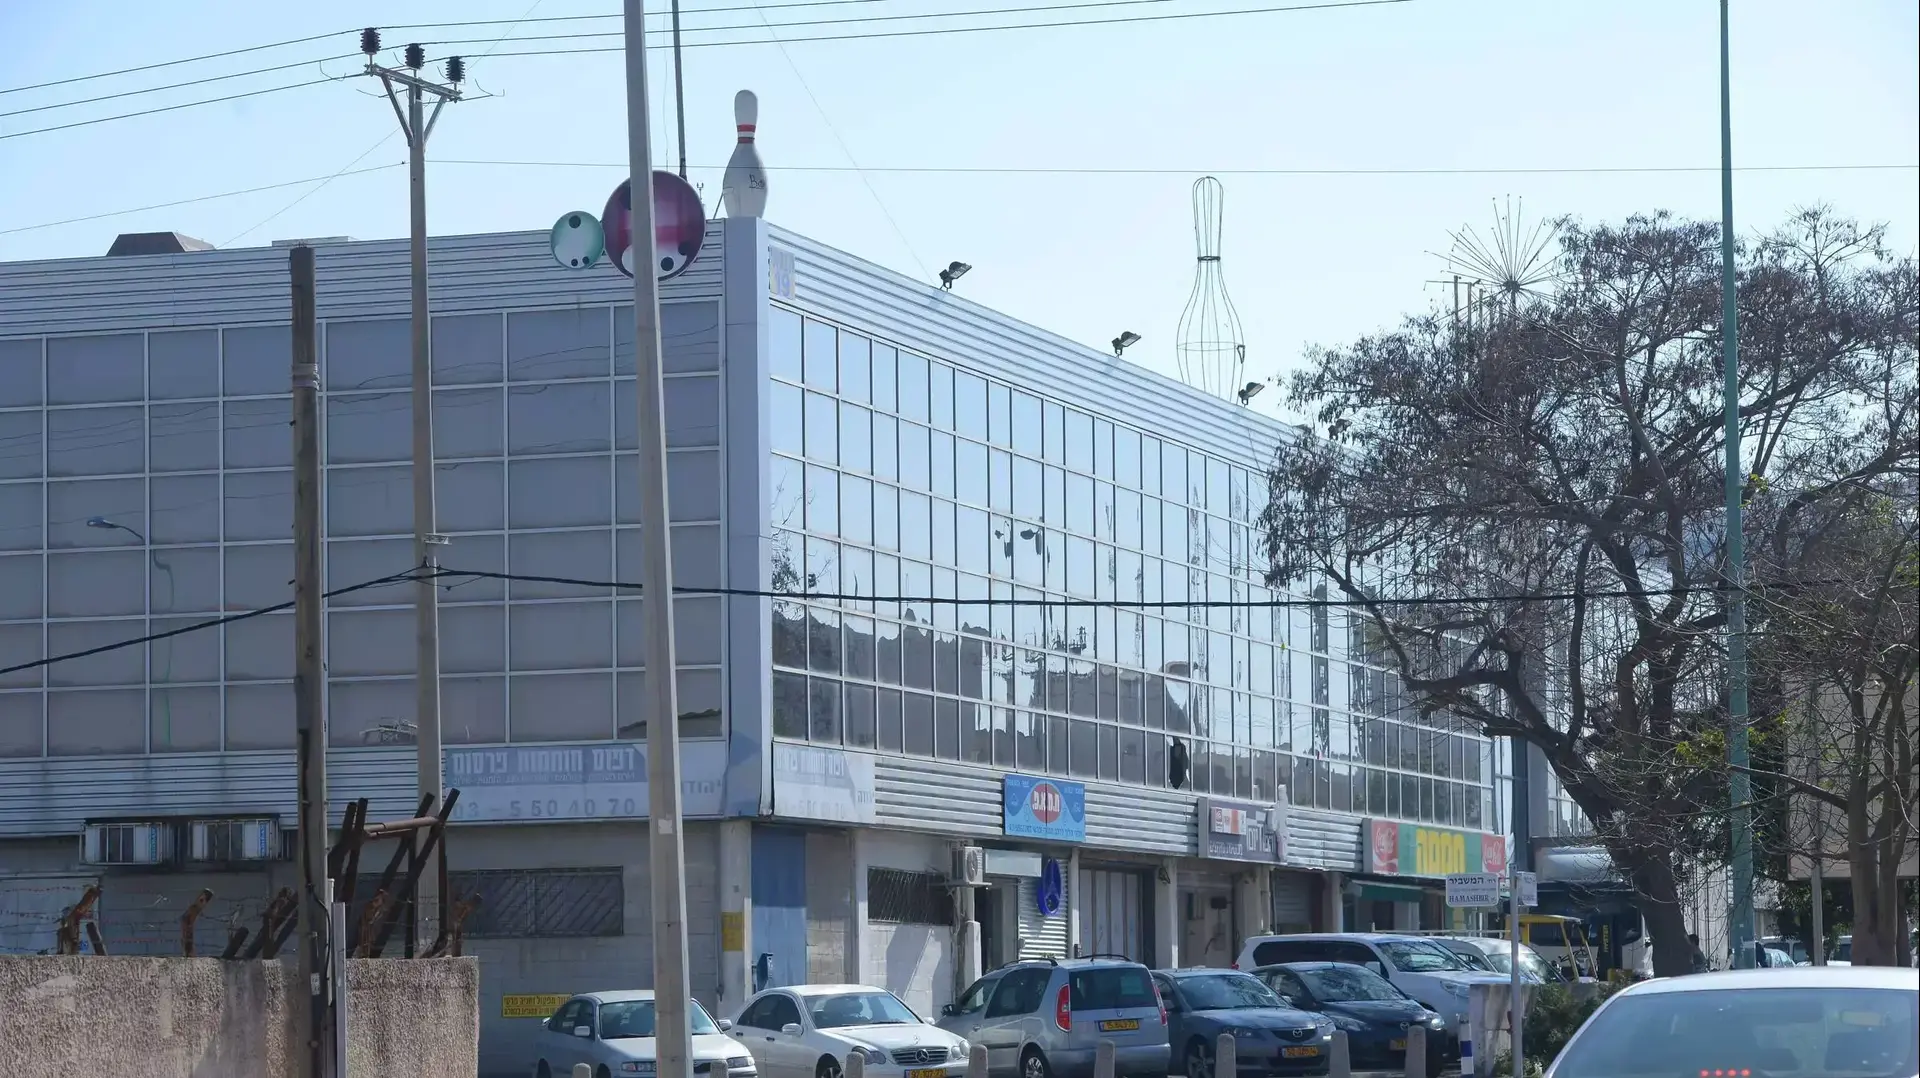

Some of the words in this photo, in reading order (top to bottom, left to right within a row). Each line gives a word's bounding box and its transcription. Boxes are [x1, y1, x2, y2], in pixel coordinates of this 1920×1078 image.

[517, 750, 584, 773] חותמות
[592, 748, 635, 771] דפוס
[1448, 876, 1484, 885] המשביר
[1449, 894, 1489, 903] HAMASHBIR
